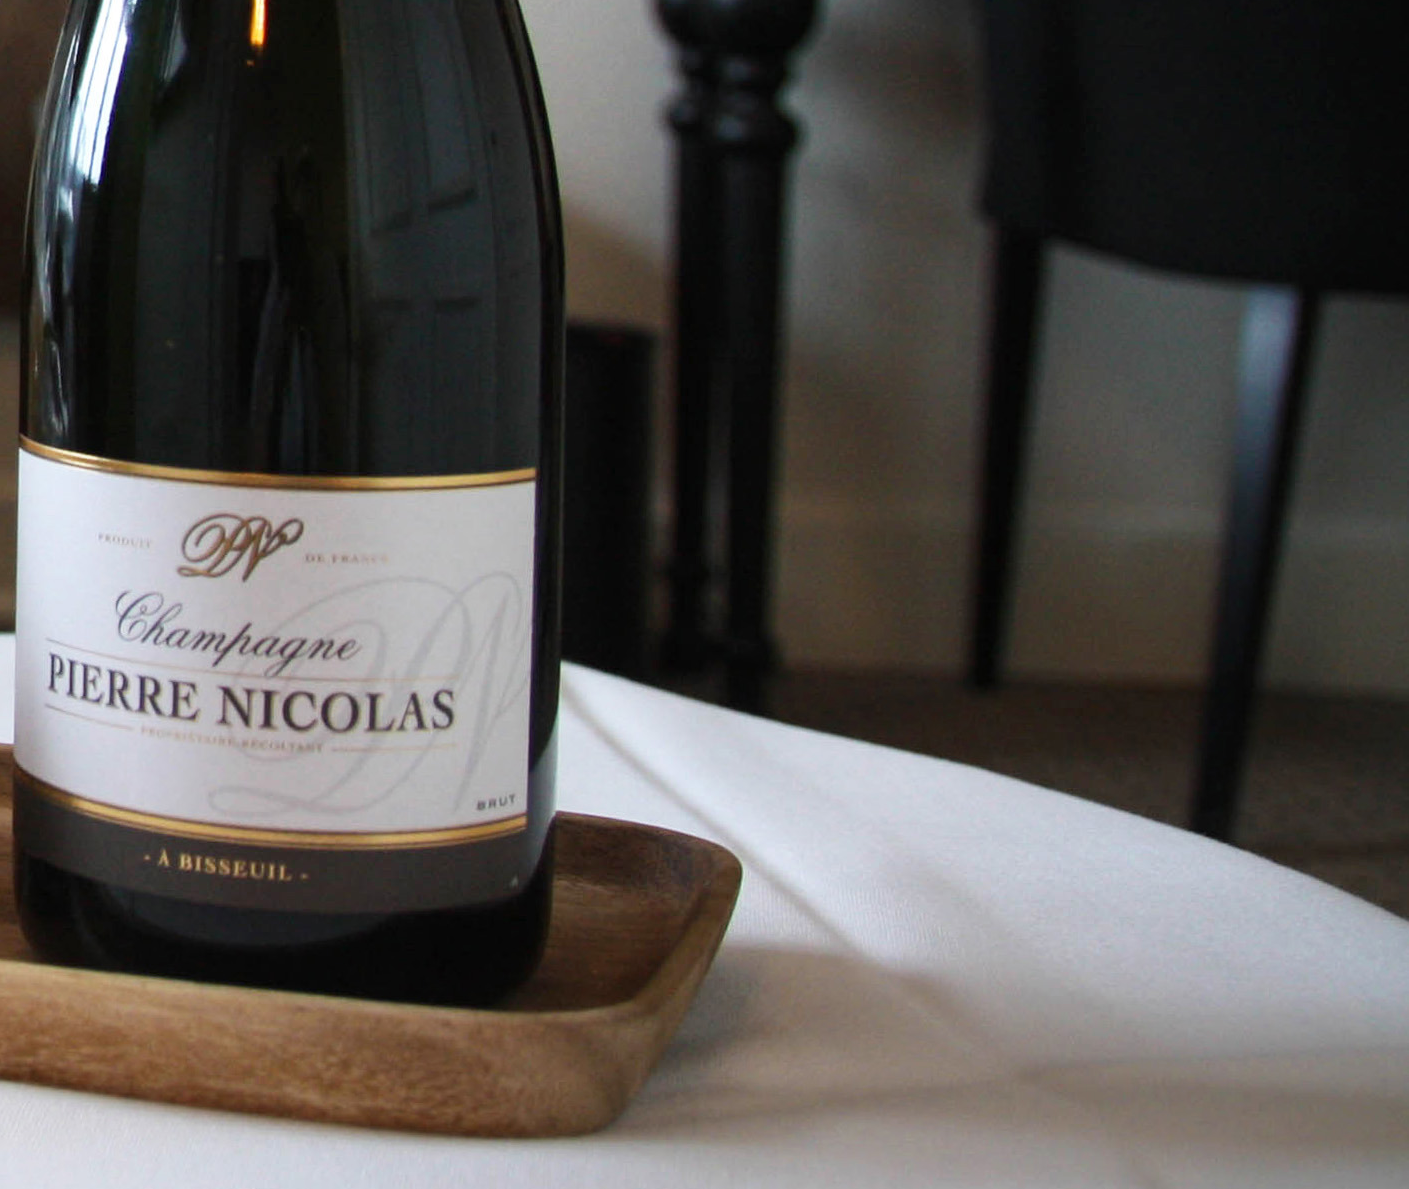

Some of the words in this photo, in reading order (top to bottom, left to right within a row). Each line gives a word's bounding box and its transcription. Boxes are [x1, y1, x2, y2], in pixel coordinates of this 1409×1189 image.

[115, 590, 361, 677] Champagne
[47, 652, 202, 723] PIERRE
[216, 685, 456, 735] NICOLAS
[477, 793, 517, 811] BRUT
[178, 852, 293, 881] BISSEUIL
